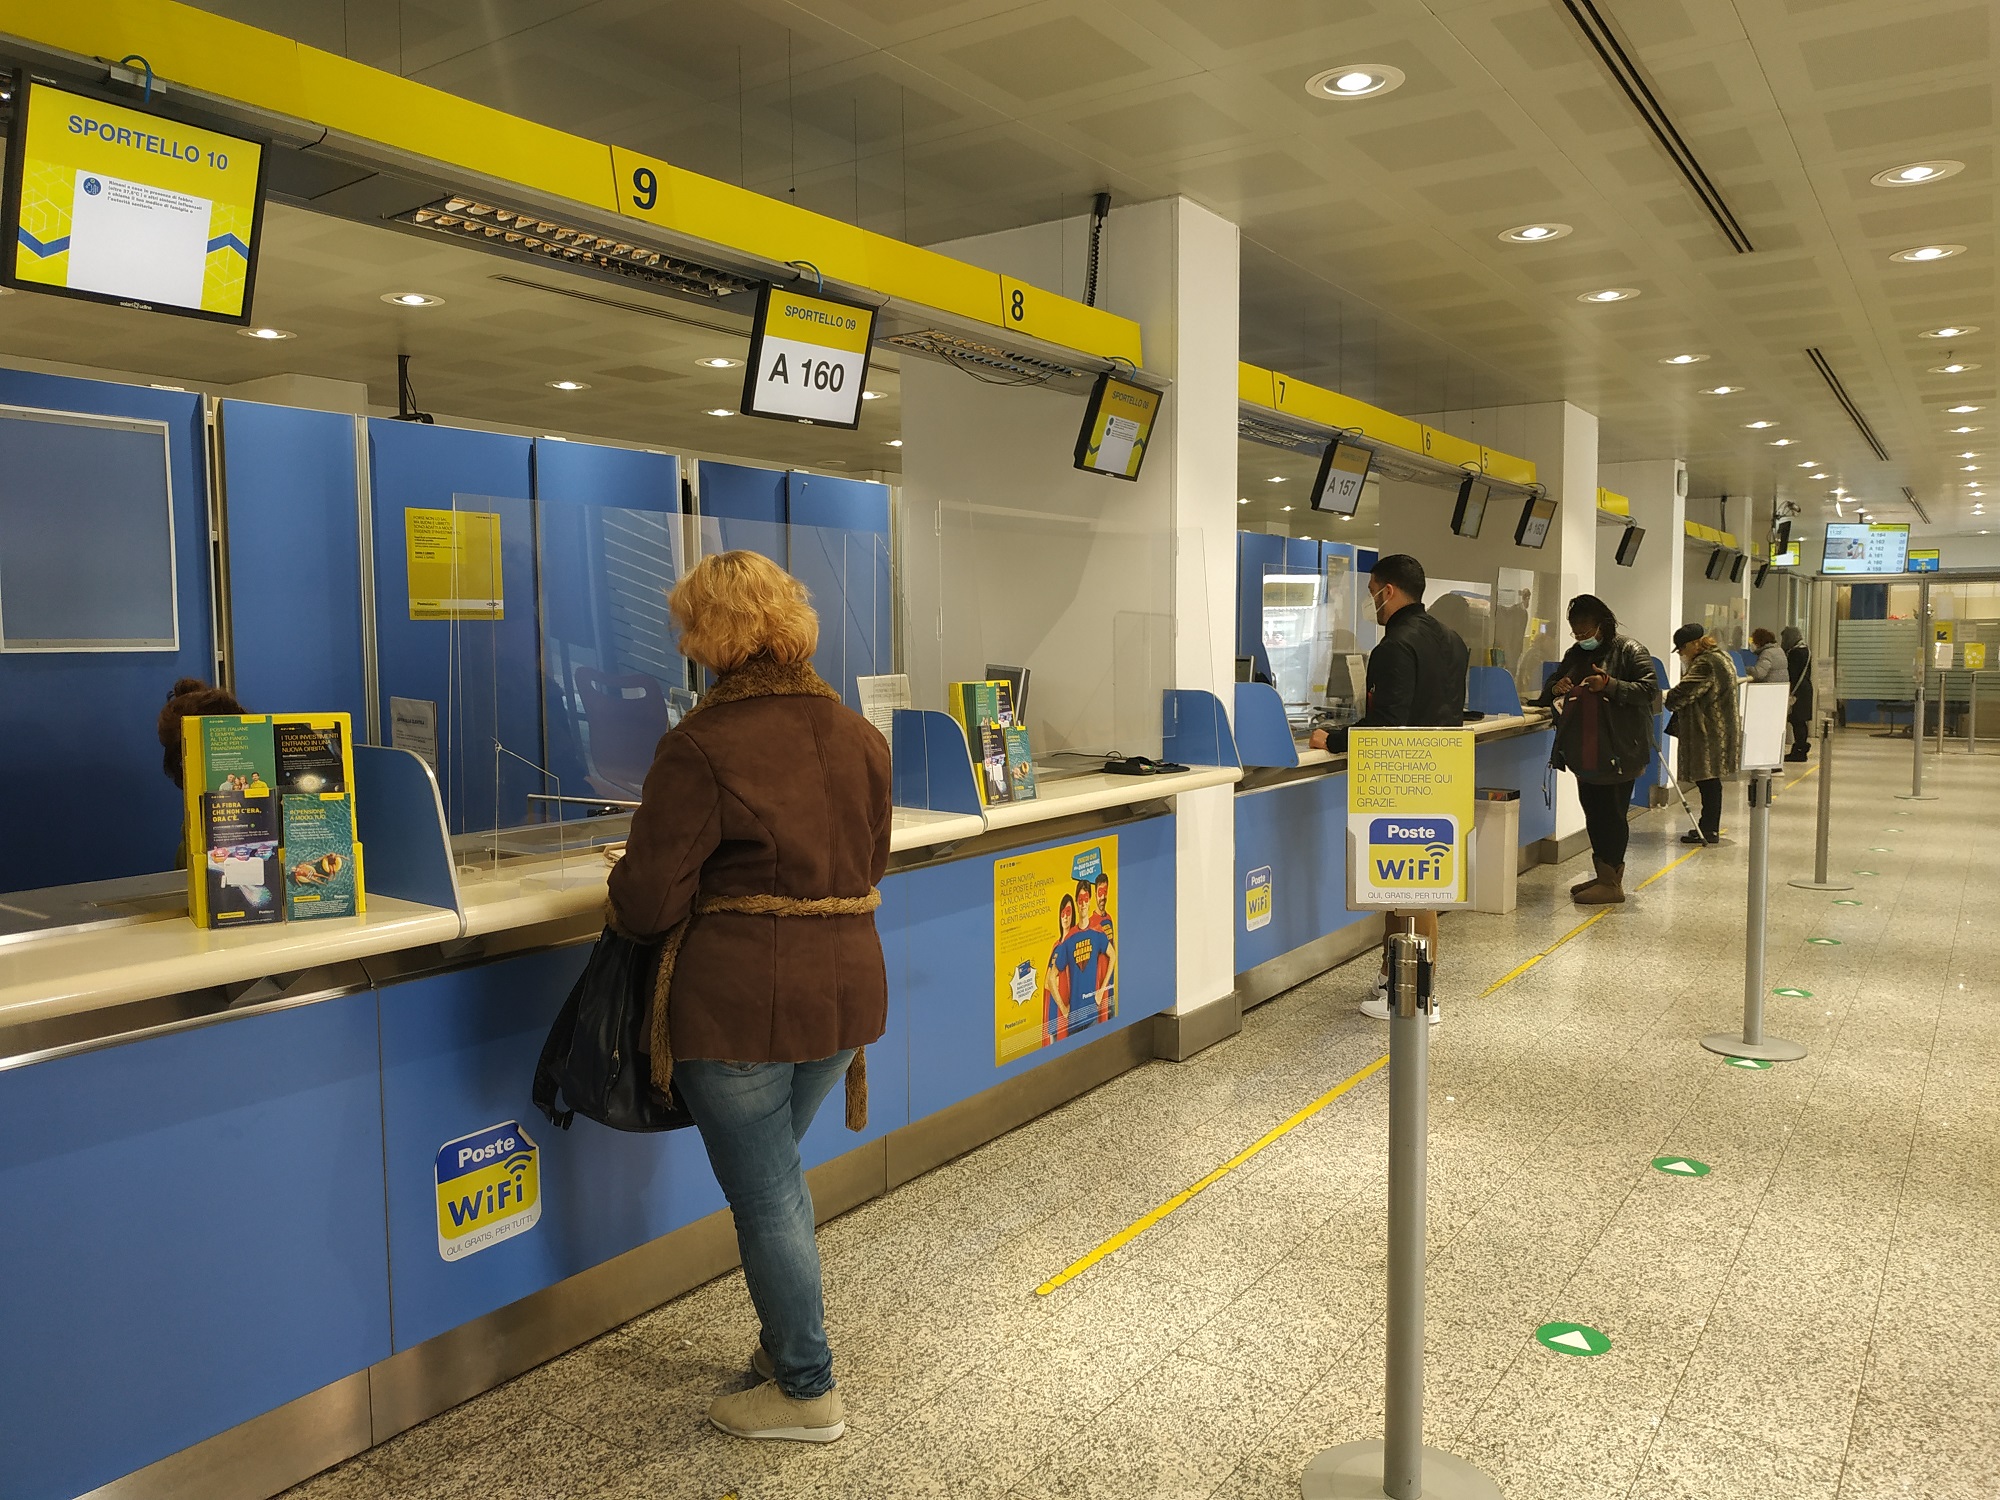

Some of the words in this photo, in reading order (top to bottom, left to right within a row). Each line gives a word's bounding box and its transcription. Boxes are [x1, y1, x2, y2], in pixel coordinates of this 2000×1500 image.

[68, 115, 200, 163] SPORTELLO
[207, 152, 228, 170] 10
[632, 167, 658, 210] 9
[1011, 289, 1024, 321] 8
[785, 305, 843, 328] SPORTELLO
[845, 319, 856, 330] 09
[768, 353, 789, 385] A
[801, 359, 845, 393] 160
[1112, 391, 1142, 407] SPORTELLO
[1278, 381, 1285, 404] 7
[1425, 432, 1431, 451] 6
[1484, 453, 1489, 469] 5
[1327, 477, 1336, 493] A
[1339, 480, 1356, 496] 157
[1357, 738, 1378, 747] PER
[1381, 738, 1404, 747] UNA
[1406, 738, 1462, 747] MAGGIORE
[1357, 749, 1433, 759] RISERVATEZZA
[1357, 761, 1371, 771] LA
[1373, 761, 1437, 771] PREGHIAMO
[1357, 774, 1367, 783] DI
[1370, 774, 1431, 783] ATTENDERE
[1434, 774, 1452, 784] QUI
[1357, 786, 1365, 795] IL
[1368, 786, 1391, 796] SUO
[1394, 786, 1433, 796] TURNO.
[1356, 798, 1397, 808] GRAZIE.
[1387, 824, 1436, 839] Poste
[1376, 858, 1440, 881] WiFi
[1000, 877, 1017, 887] SUPER
[1000, 887, 1012, 897] ALLE
[1012, 885, 1029, 894] POSTE
[1033, 877, 1055, 888] ARRIVATA
[1251, 874, 1266, 886] Poste
[1000, 899, 1007, 907] LA
[1007, 894, 1024, 905] NUOVA
[1004, 905, 1018, 915] MESE
[1019, 900, 1036, 911] GRATIS
[1036, 898, 1045, 907] PER
[1248, 895, 1267, 914] WiFi
[458, 1137, 516, 1169] Poste
[447, 1174, 523, 1228] WiFi
[446, 1245, 463, 1256] QUI,
[464, 1232, 494, 1249] GRATIS,
[495, 1223, 511, 1236] PER
[511, 1214, 534, 1227] TUTTI.
